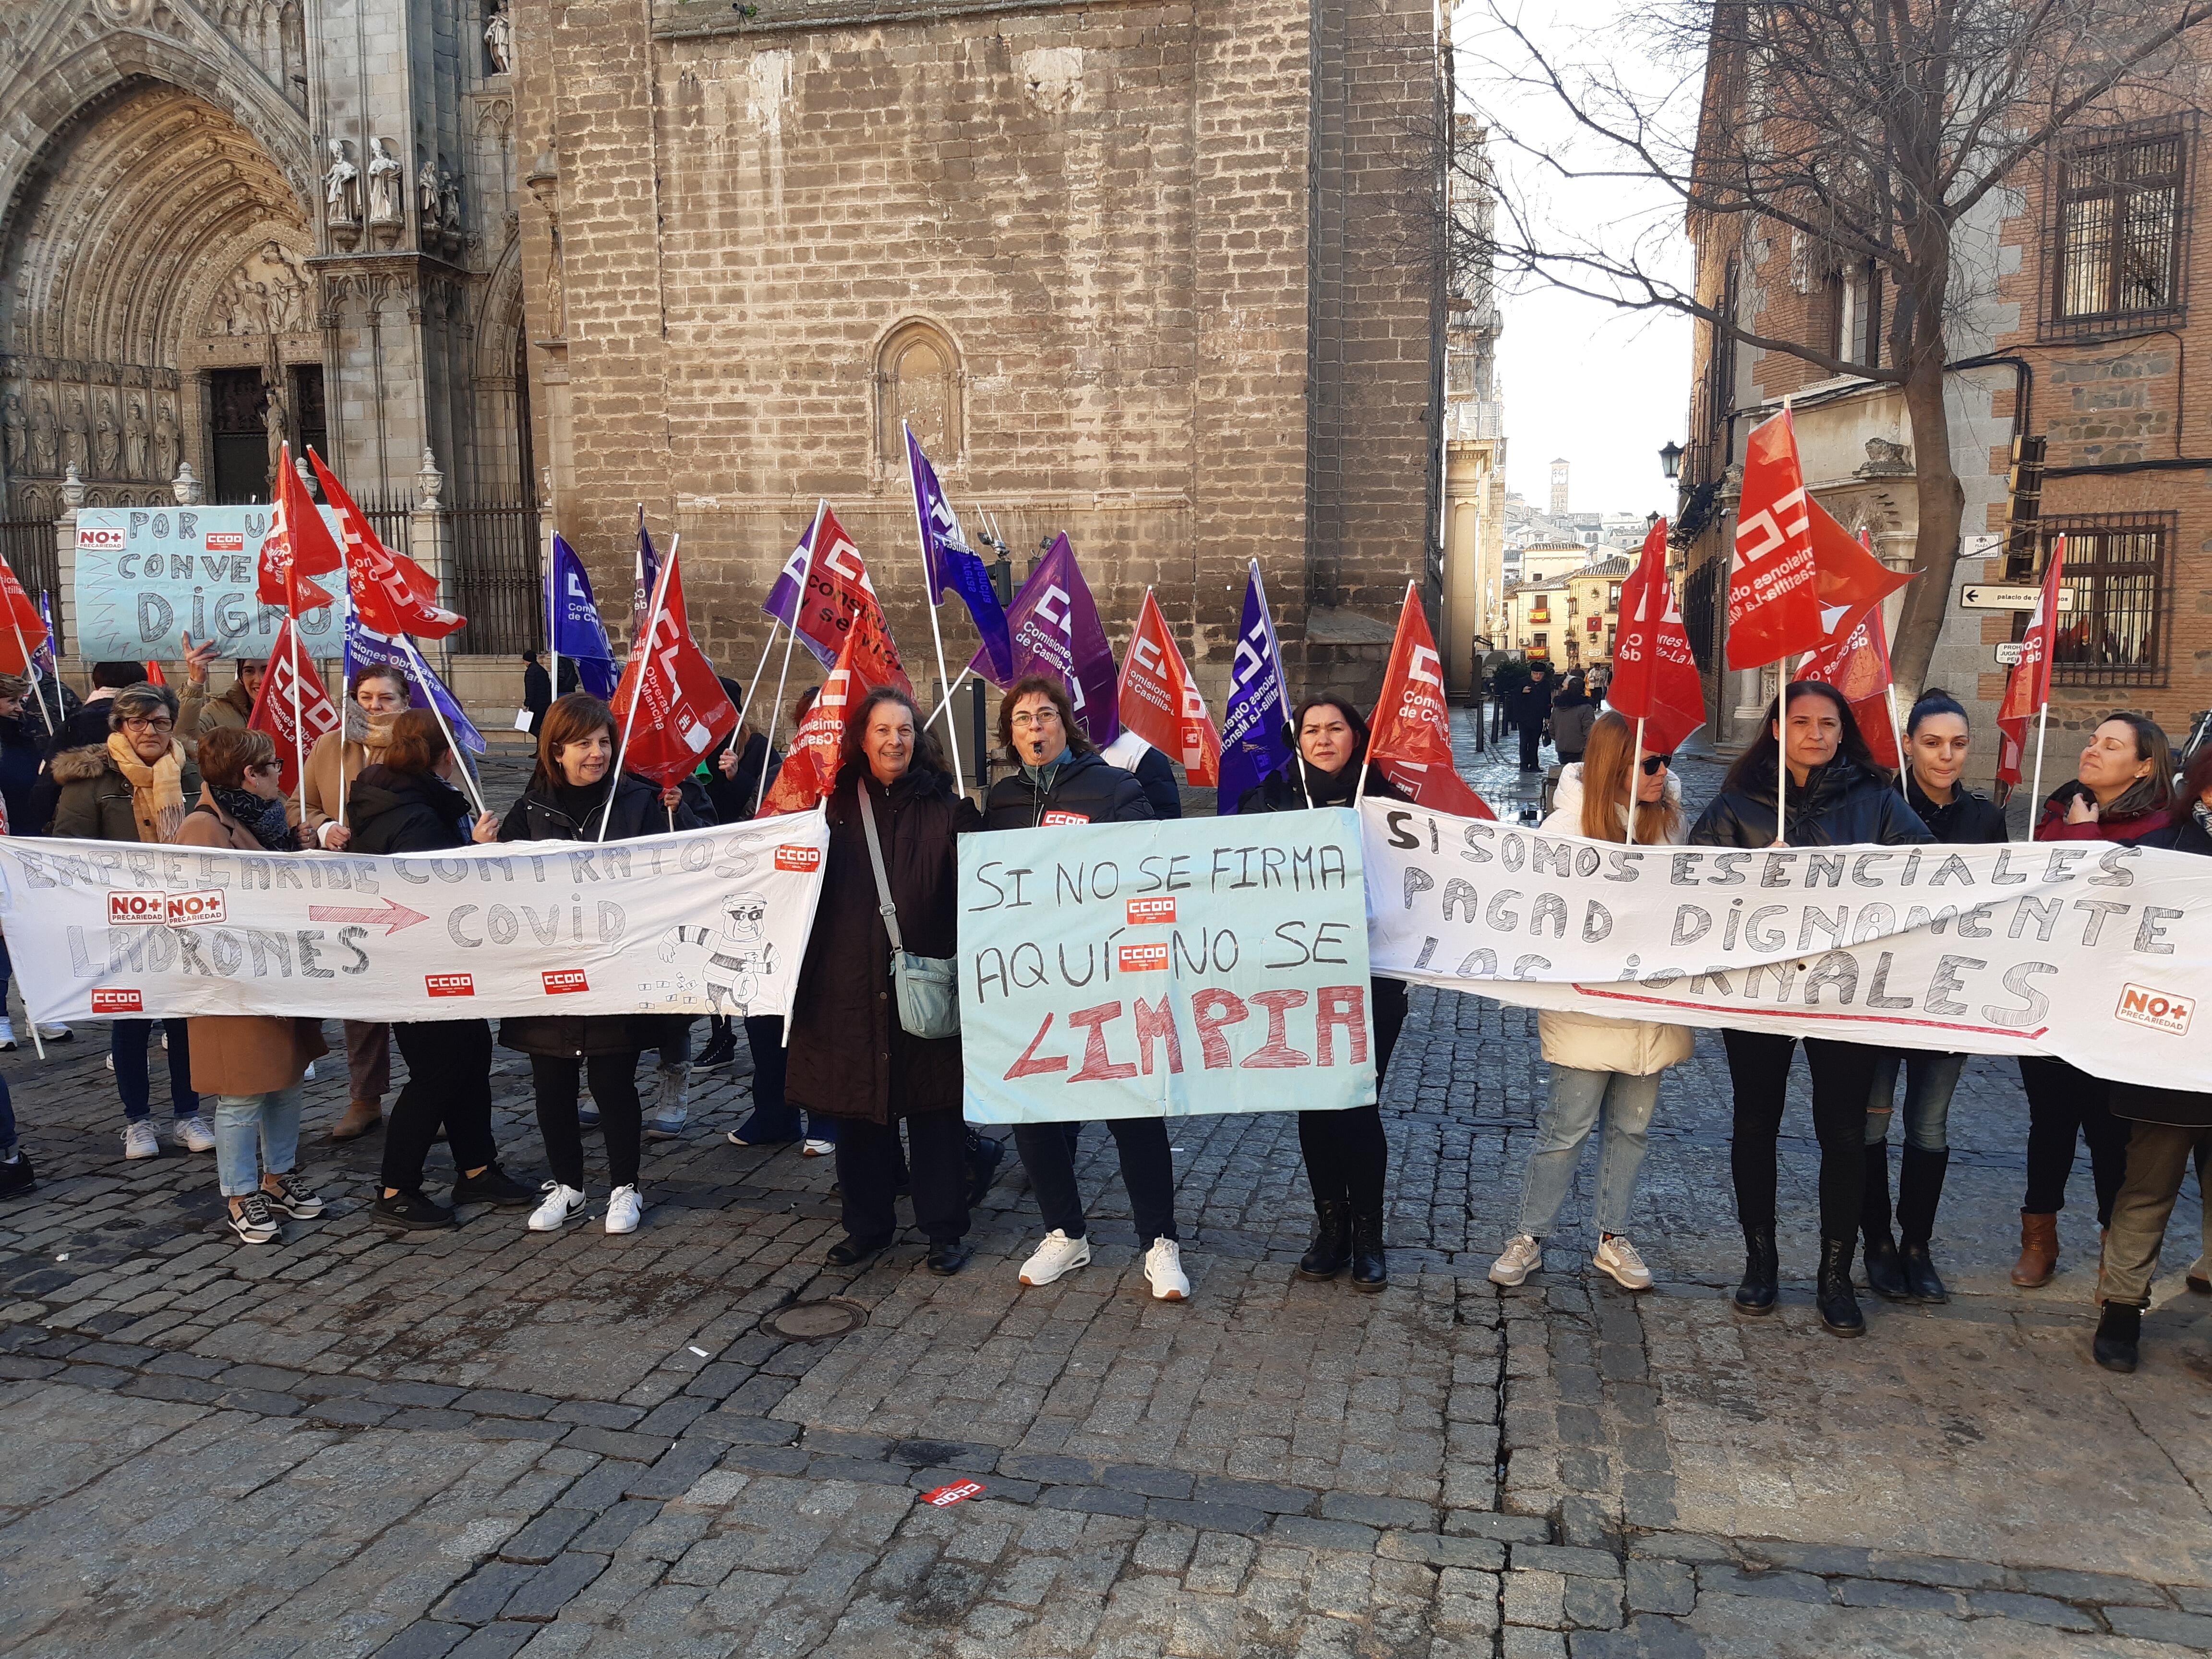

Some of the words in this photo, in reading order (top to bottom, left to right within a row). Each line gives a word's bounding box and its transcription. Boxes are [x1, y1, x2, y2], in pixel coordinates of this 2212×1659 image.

[130, 512, 198, 539] POR
[245, 513, 264, 538] U
[80, 531, 121, 543] NO+
[118, 553, 251, 582] CONVE
[808, 574, 888, 633] constru
[568, 613, 581, 621] de
[1015, 633, 1031, 647] de
[1033, 642, 1075, 679] Castilla-L
[645, 666, 670, 714] Obreras
[641, 682, 665, 731] Mancha
[1399, 705, 1417, 718] de
[1045, 814, 1087, 825] CCOO
[777, 849, 818, 861] CCOO
[1387, 810, 1439, 854] SI
[1461, 824, 1644, 882] SOMOS
[393, 834, 765, 884] CONTRATOS
[967, 862, 1034, 912] SI
[1056, 862, 1119, 907] NO
[1136, 855, 1191, 892] SE
[1212, 845, 1345, 894] FIRMA
[112, 897, 162, 914] NO+
[168, 897, 220, 918] NO+
[1129, 901, 1173, 913] CCOO
[1404, 866, 1612, 944] PAGAD
[169, 912, 221, 924] PRECARIEDAD
[67, 926, 370, 978] LADRONES
[1121, 947, 1166, 960] CCOO
[1172, 928, 1238, 980] NO
[1264, 921, 1351, 969] SE
[428, 977, 471, 987] CCOO
[544, 974, 584, 985] CCOO
[94, 993, 139, 1003] CCOO
[2123, 989, 2187, 1020] NO+
[2121, 1009, 2183, 1030] PRECARIEDAD
[1003, 985, 1367, 1083] LIMPIA
[932, 1483, 981, 1505] CCOO
